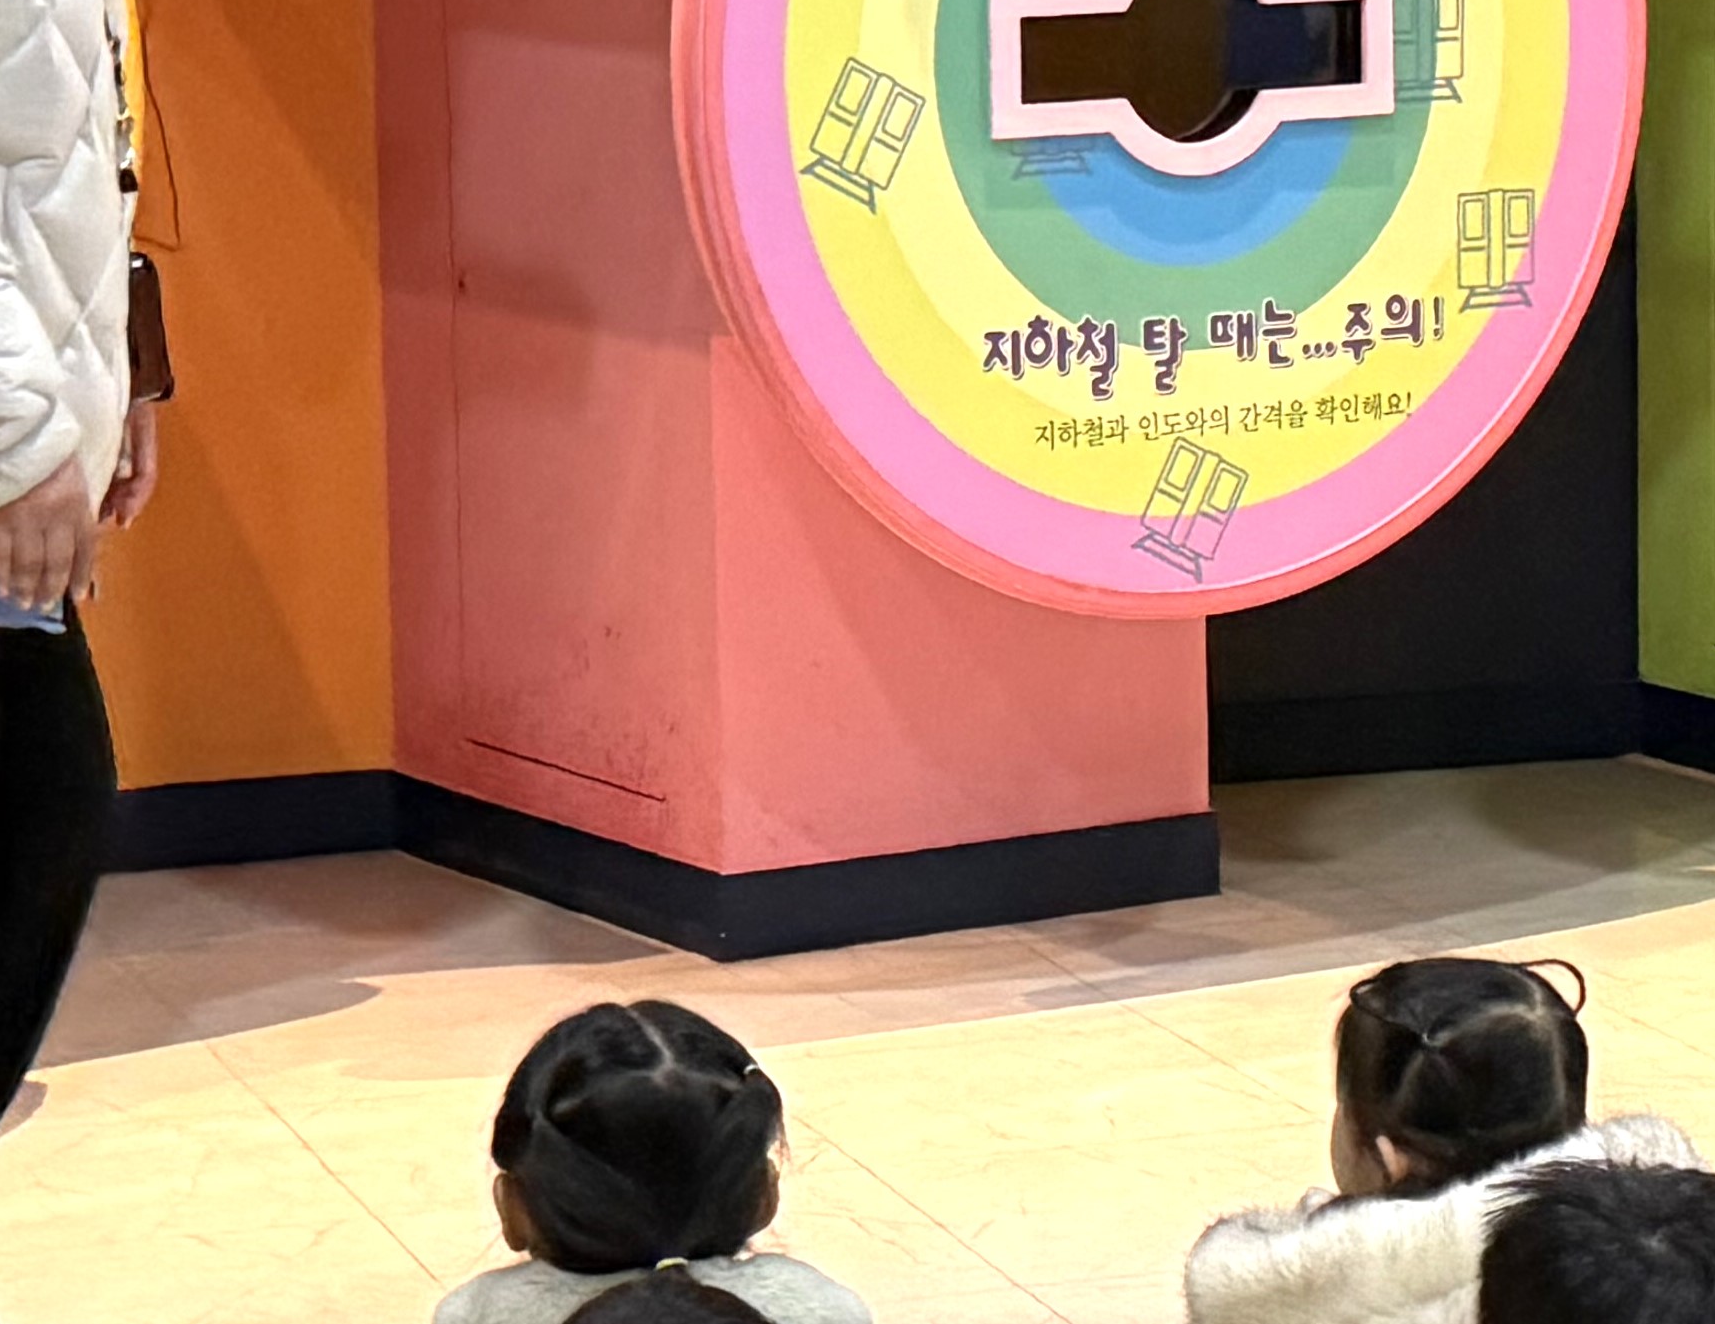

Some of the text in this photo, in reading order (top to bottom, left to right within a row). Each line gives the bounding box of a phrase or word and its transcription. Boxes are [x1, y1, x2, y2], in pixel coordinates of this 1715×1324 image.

[982, 315, 1118, 400] 지하철
[1142, 316, 1188, 394] 탈
[1035, 391, 1412, 450] 지하철과 인도와의 간격을 확인해요!
